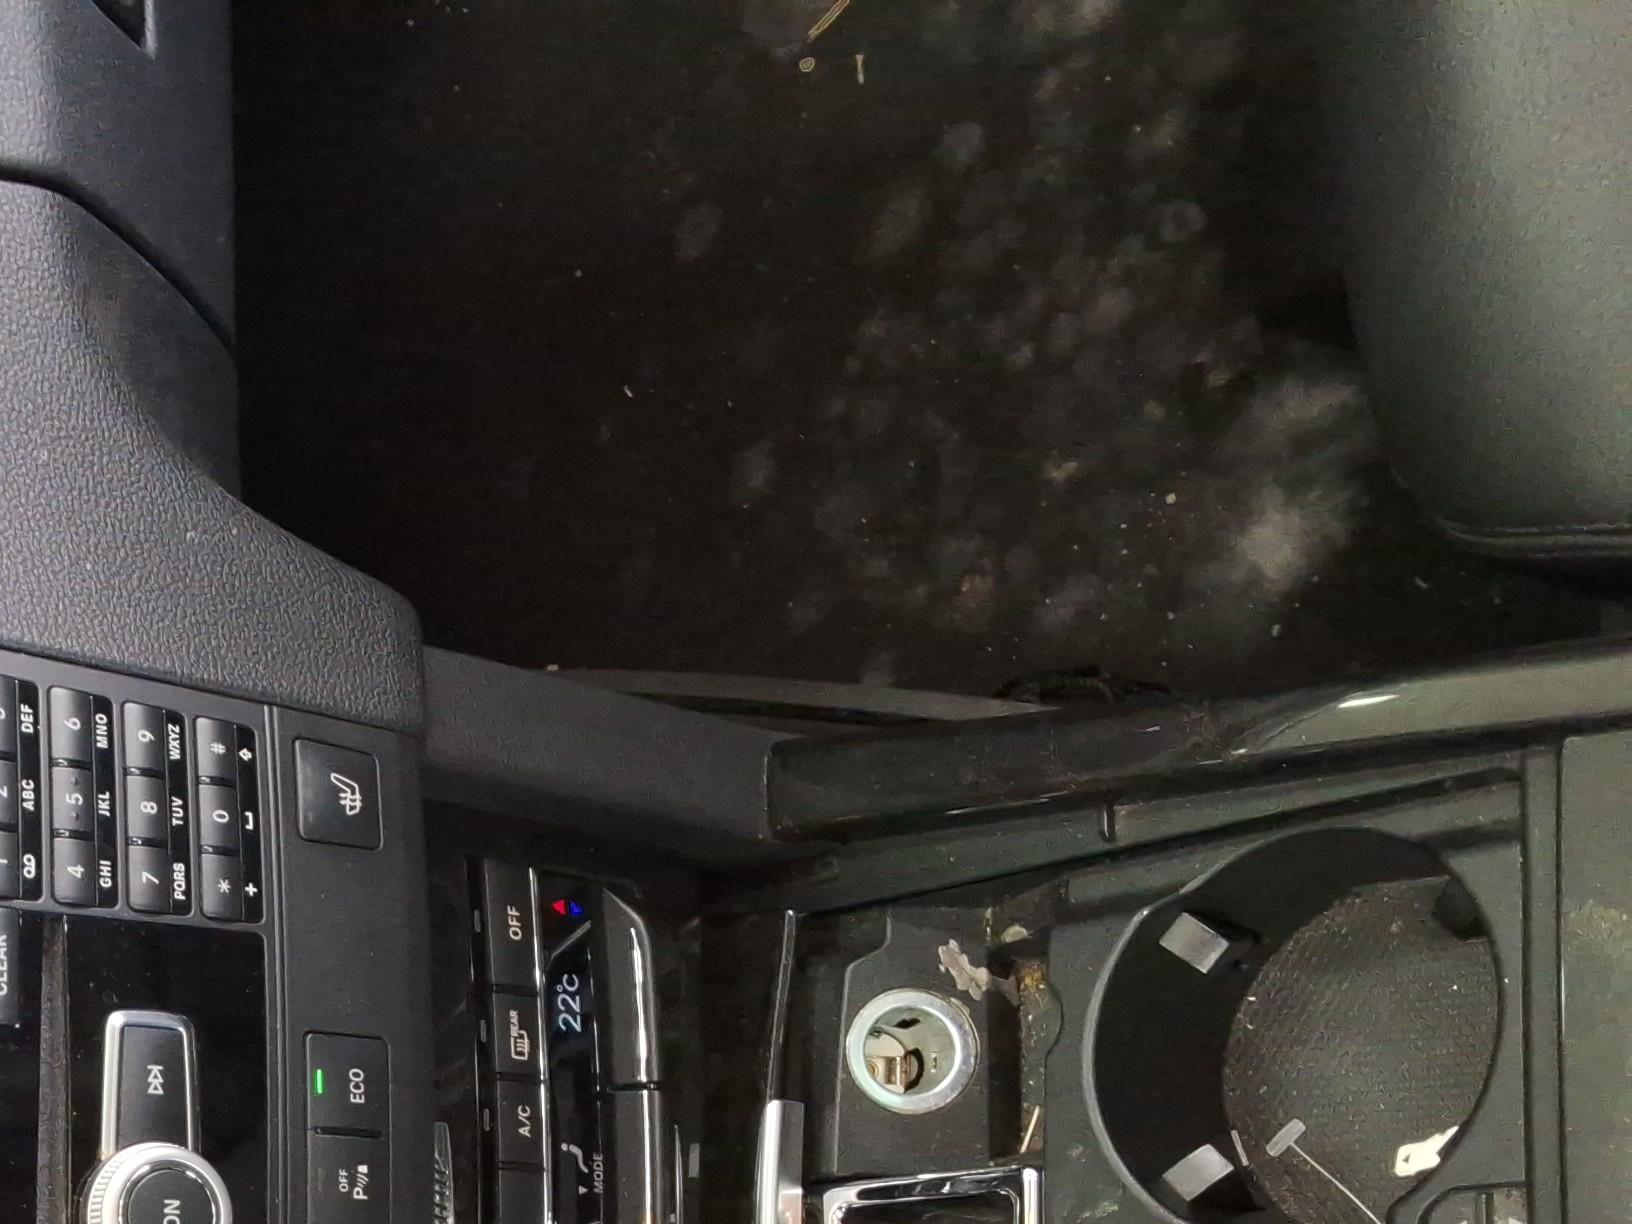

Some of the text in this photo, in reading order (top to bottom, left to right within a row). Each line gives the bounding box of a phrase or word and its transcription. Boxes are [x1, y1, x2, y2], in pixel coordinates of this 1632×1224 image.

[20, 704, 35, 734] DEF
[63, 718, 82, 731] 6
[94, 712, 109, 749] MNO
[137, 730, 155, 743] 9
[167, 723, 182, 761] WXYZ
[21, 778, 36, 811] ABC
[65, 793, 84, 806] 5
[96, 790, 111, 817] JKL
[139, 800, 158, 814] 8
[170, 796, 185, 827] TUV
[212, 810, 230, 824] 0
[66, 864, 86, 879] 4
[97, 859, 113, 888] GHI
[141, 871, 160, 885] 7
[171, 862, 187, 900] PQRS
[506, 904, 523, 941] OFF
[508, 1009, 520, 1037] REAR
[348, 1067, 366, 1104] ECO
[517, 1104, 532, 1138] A/C
[338, 1168, 349, 1193] OFF
[592, 1152, 605, 1194] MODE
